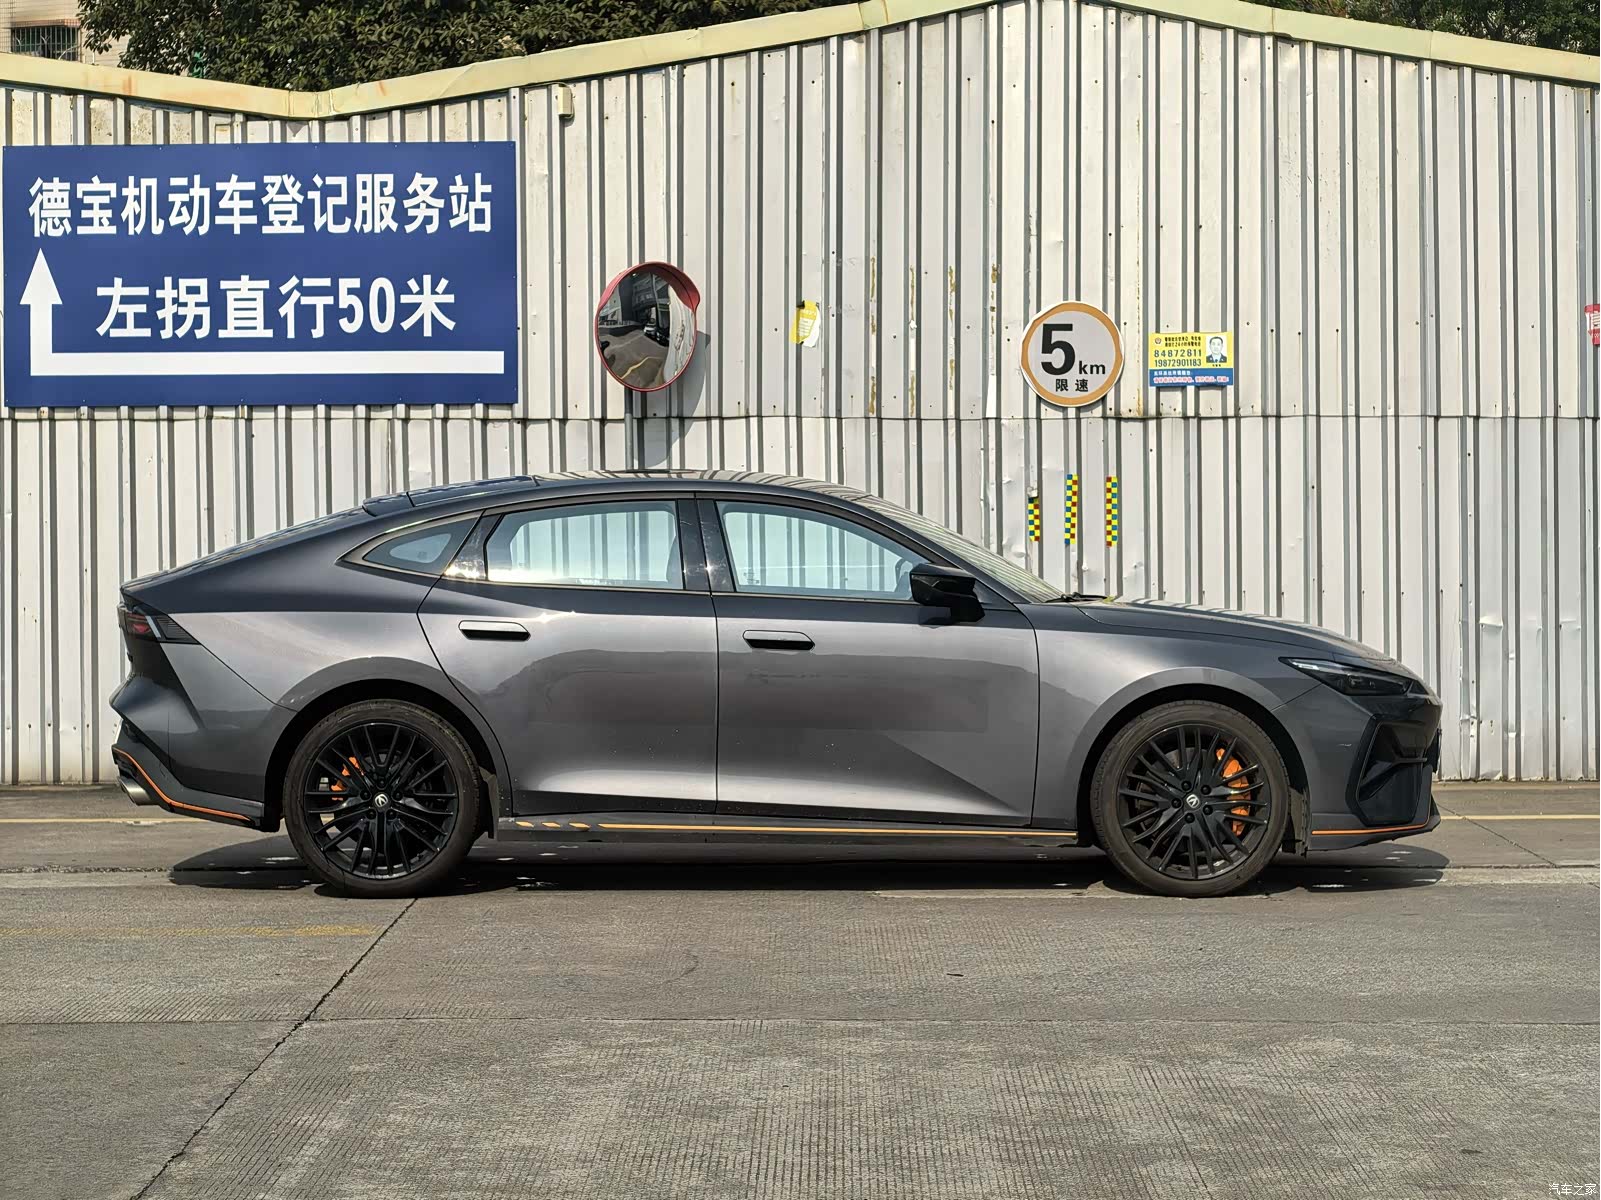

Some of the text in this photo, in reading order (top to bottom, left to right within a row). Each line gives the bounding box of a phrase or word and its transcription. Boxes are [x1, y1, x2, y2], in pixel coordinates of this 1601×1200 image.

[28, 172, 493, 237] 德宝机动车登记服务站
[95, 274, 457, 339] 左拐直行50米
[1040, 323, 1106, 376] 5 km
[1154, 349, 1202, 358] 84872811
[1055, 379, 1089, 392] 限速
